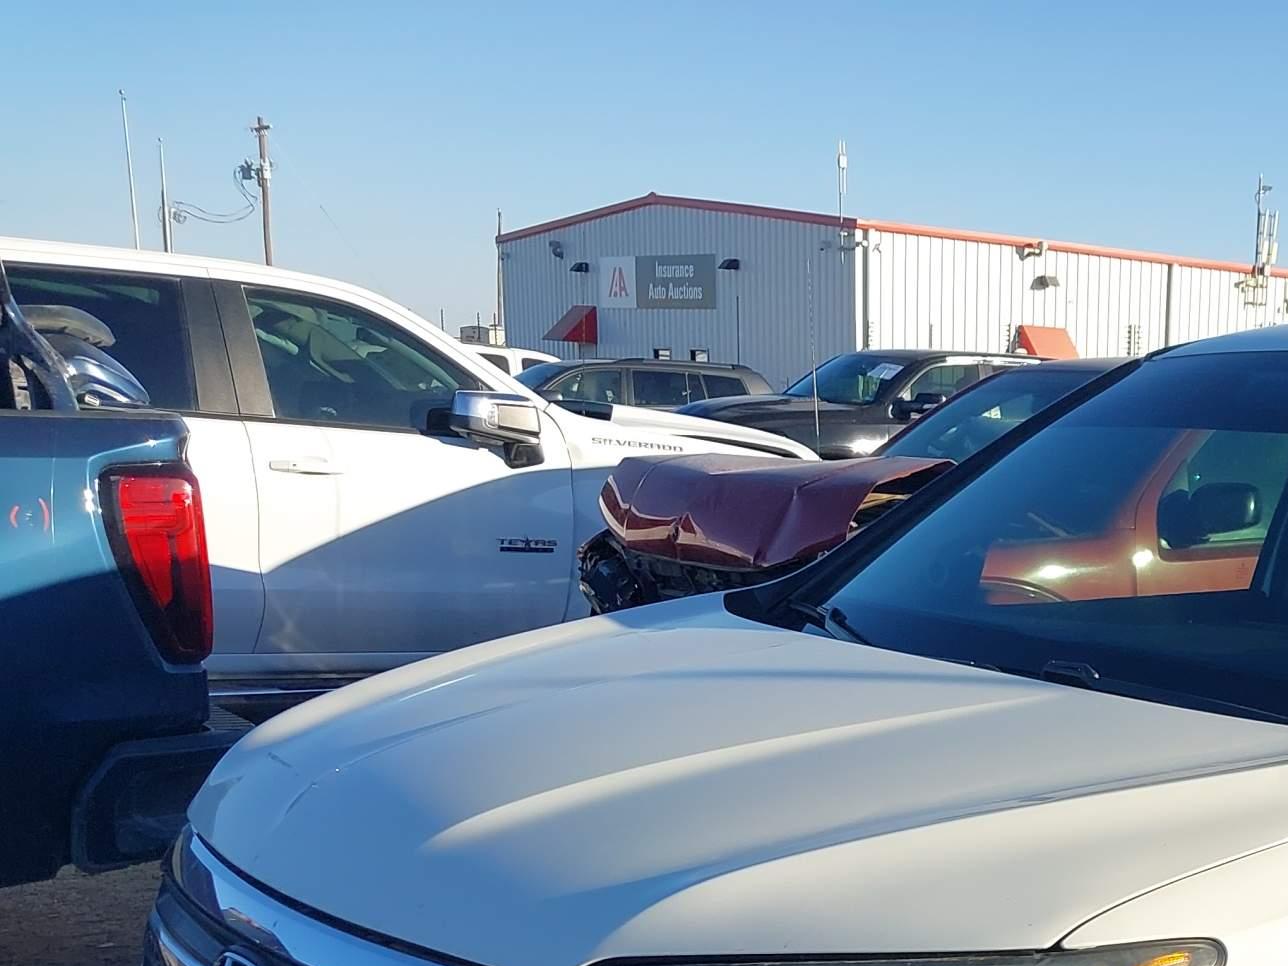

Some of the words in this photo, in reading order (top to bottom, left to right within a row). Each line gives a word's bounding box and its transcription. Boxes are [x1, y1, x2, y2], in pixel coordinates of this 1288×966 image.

[655, 260, 695, 278] Insurance
[648, 282, 666, 299] Auto
[668, 282, 703, 300] Auctions
[591, 437, 684, 453] SILVERADO
